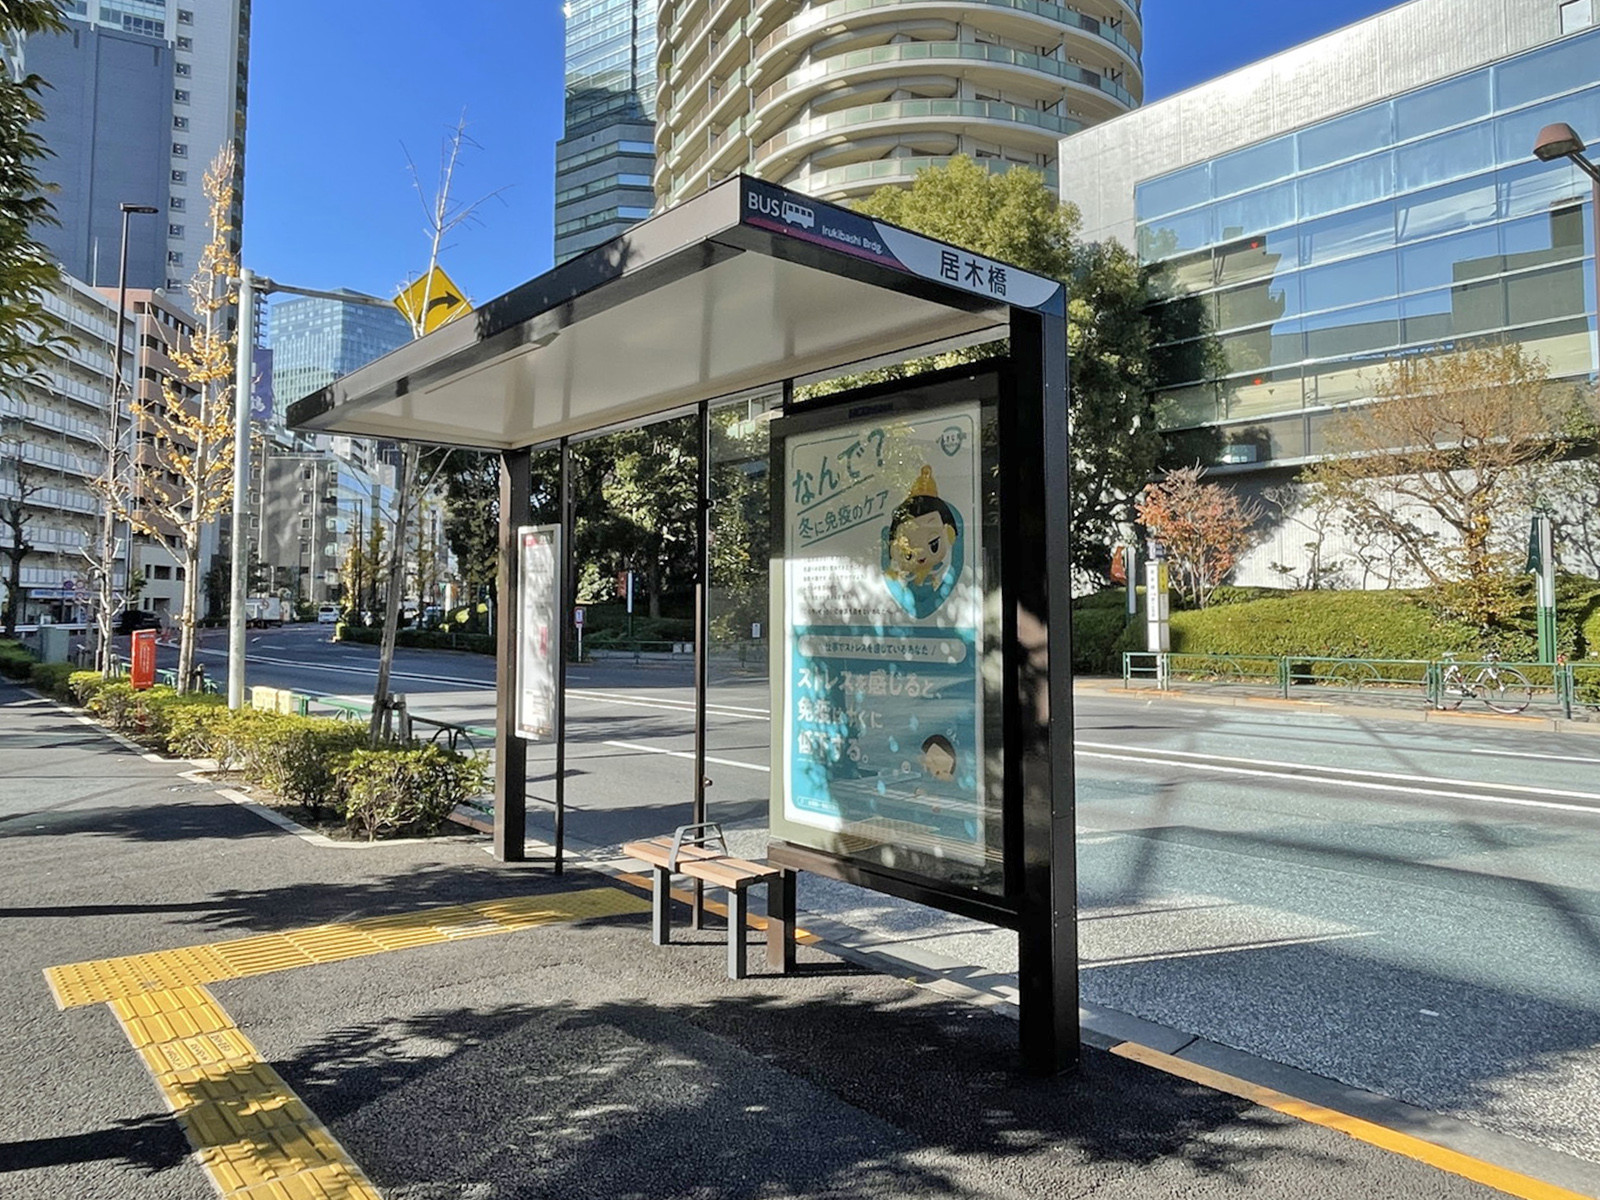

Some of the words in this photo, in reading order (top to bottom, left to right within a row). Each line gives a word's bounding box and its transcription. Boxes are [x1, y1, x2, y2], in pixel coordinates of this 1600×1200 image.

[748, 191, 780, 217] BUS
[822, 225, 861, 246] Irukibashi
[940, 250, 1007, 297] 居木橋
[798, 489, 890, 540] 冬に免疫のケア
